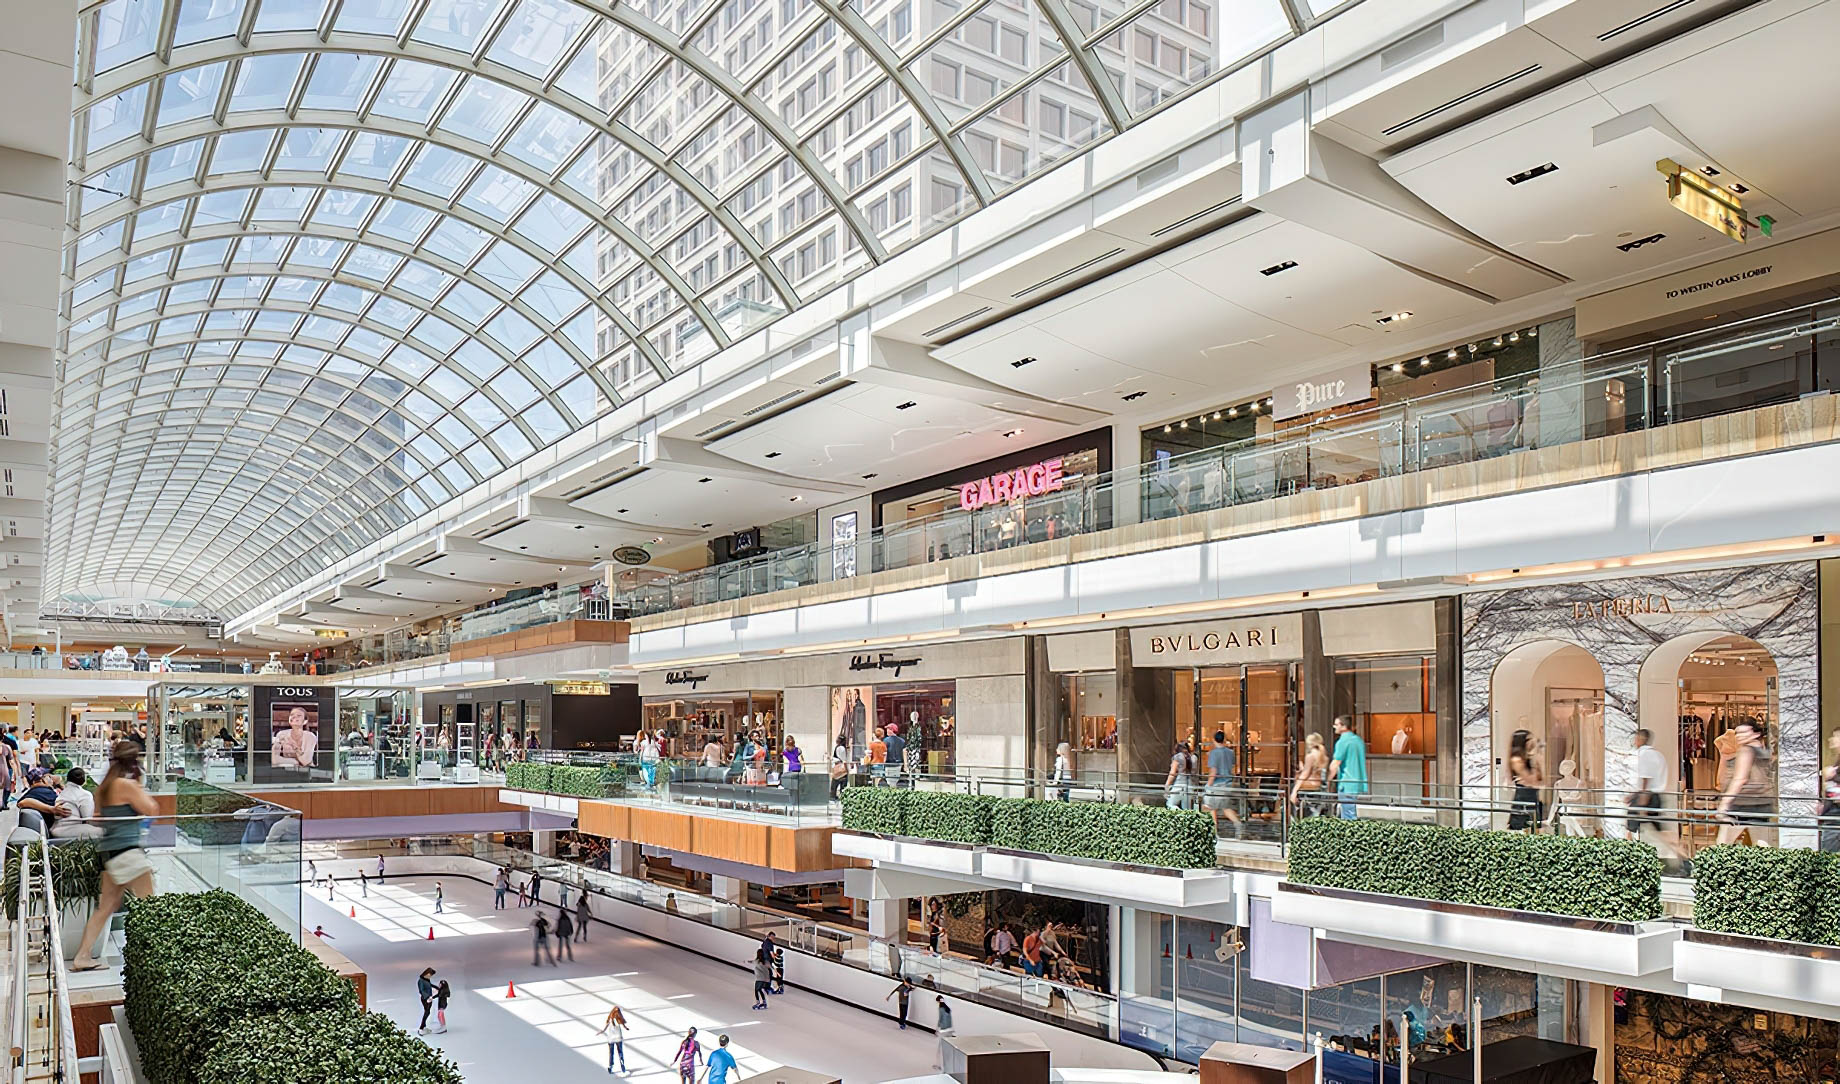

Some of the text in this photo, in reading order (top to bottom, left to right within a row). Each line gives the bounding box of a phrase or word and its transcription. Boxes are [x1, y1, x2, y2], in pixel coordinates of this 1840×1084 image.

[1666, 265, 1773, 299] TO WESTIN OAKS LOBBY
[1295, 379, 1345, 412] Pure
[960, 458, 1064, 511] GARAGE
[1151, 627, 1278, 654] BVLGARI
[276, 687, 313, 697] TOUS
